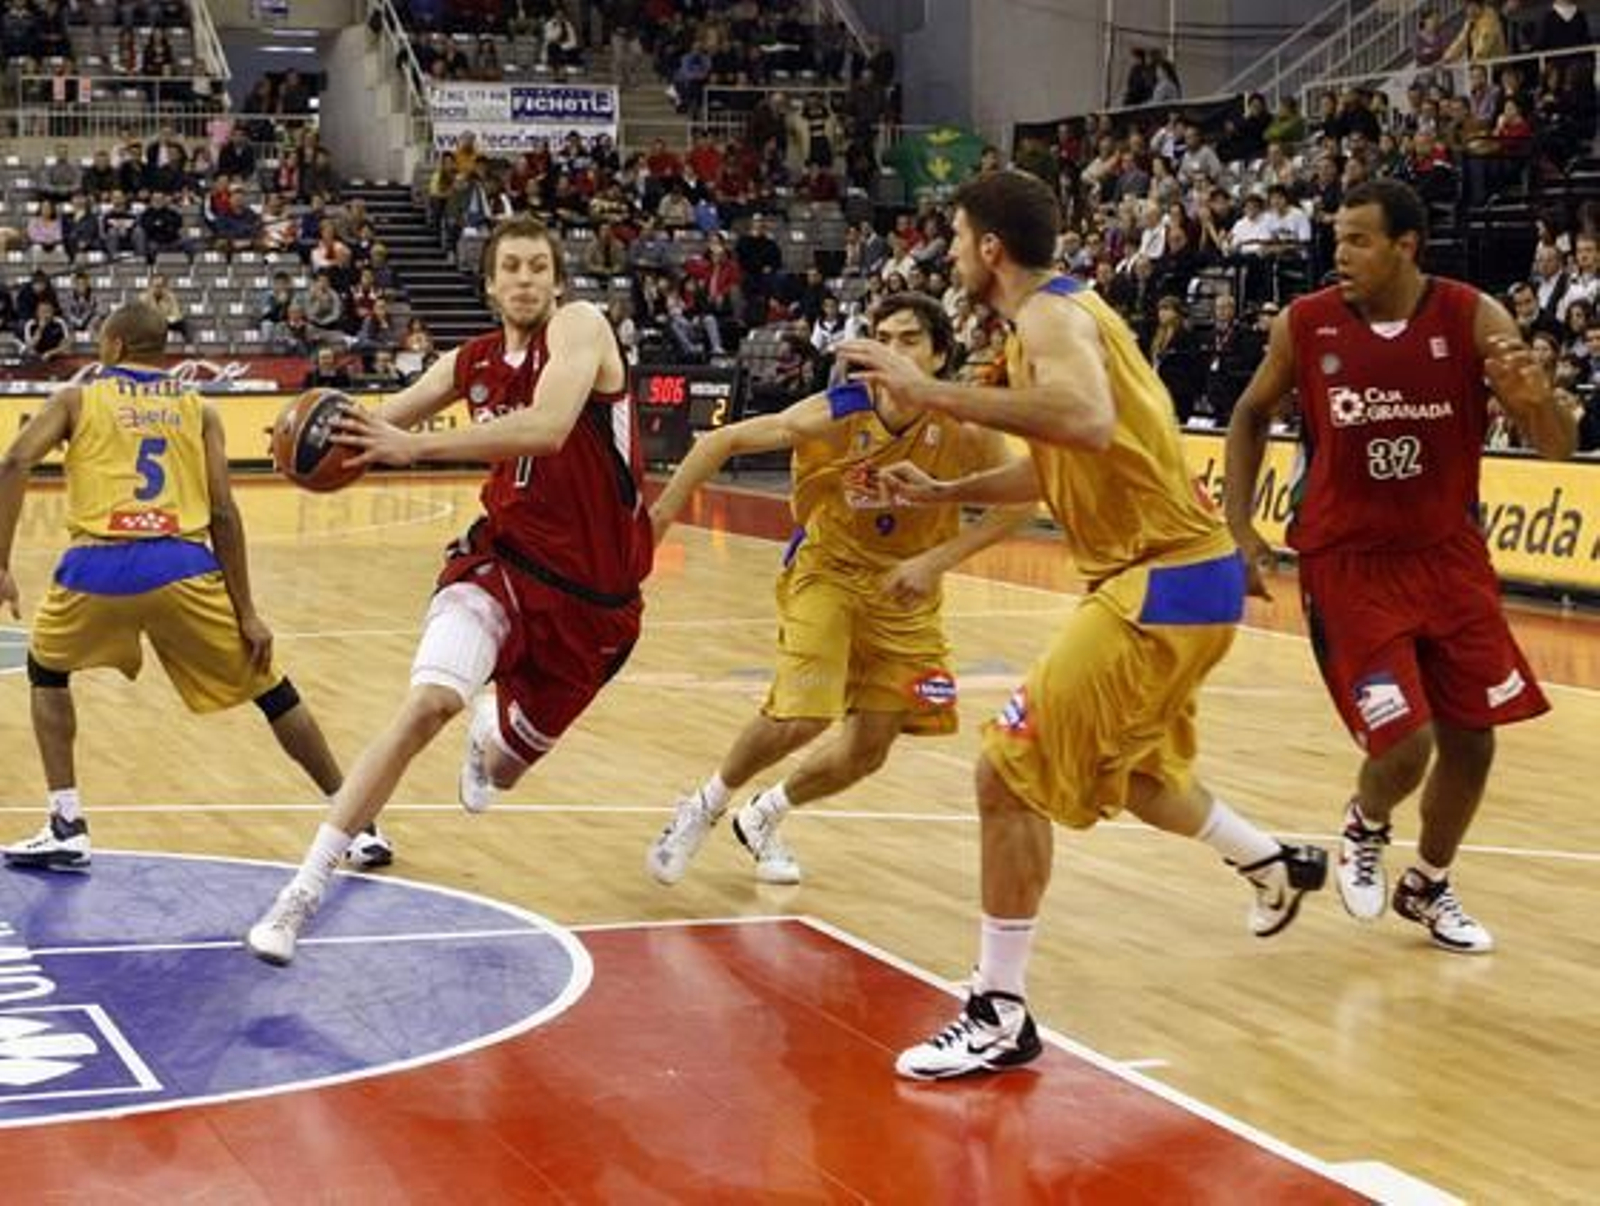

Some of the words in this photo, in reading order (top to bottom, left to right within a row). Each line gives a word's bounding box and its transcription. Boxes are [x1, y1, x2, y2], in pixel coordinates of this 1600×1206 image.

[712, 398, 727, 426] 2
[1367, 401, 1453, 422] GRANADA
[133, 437, 167, 502] 5
[1367, 435, 1423, 481] 32
